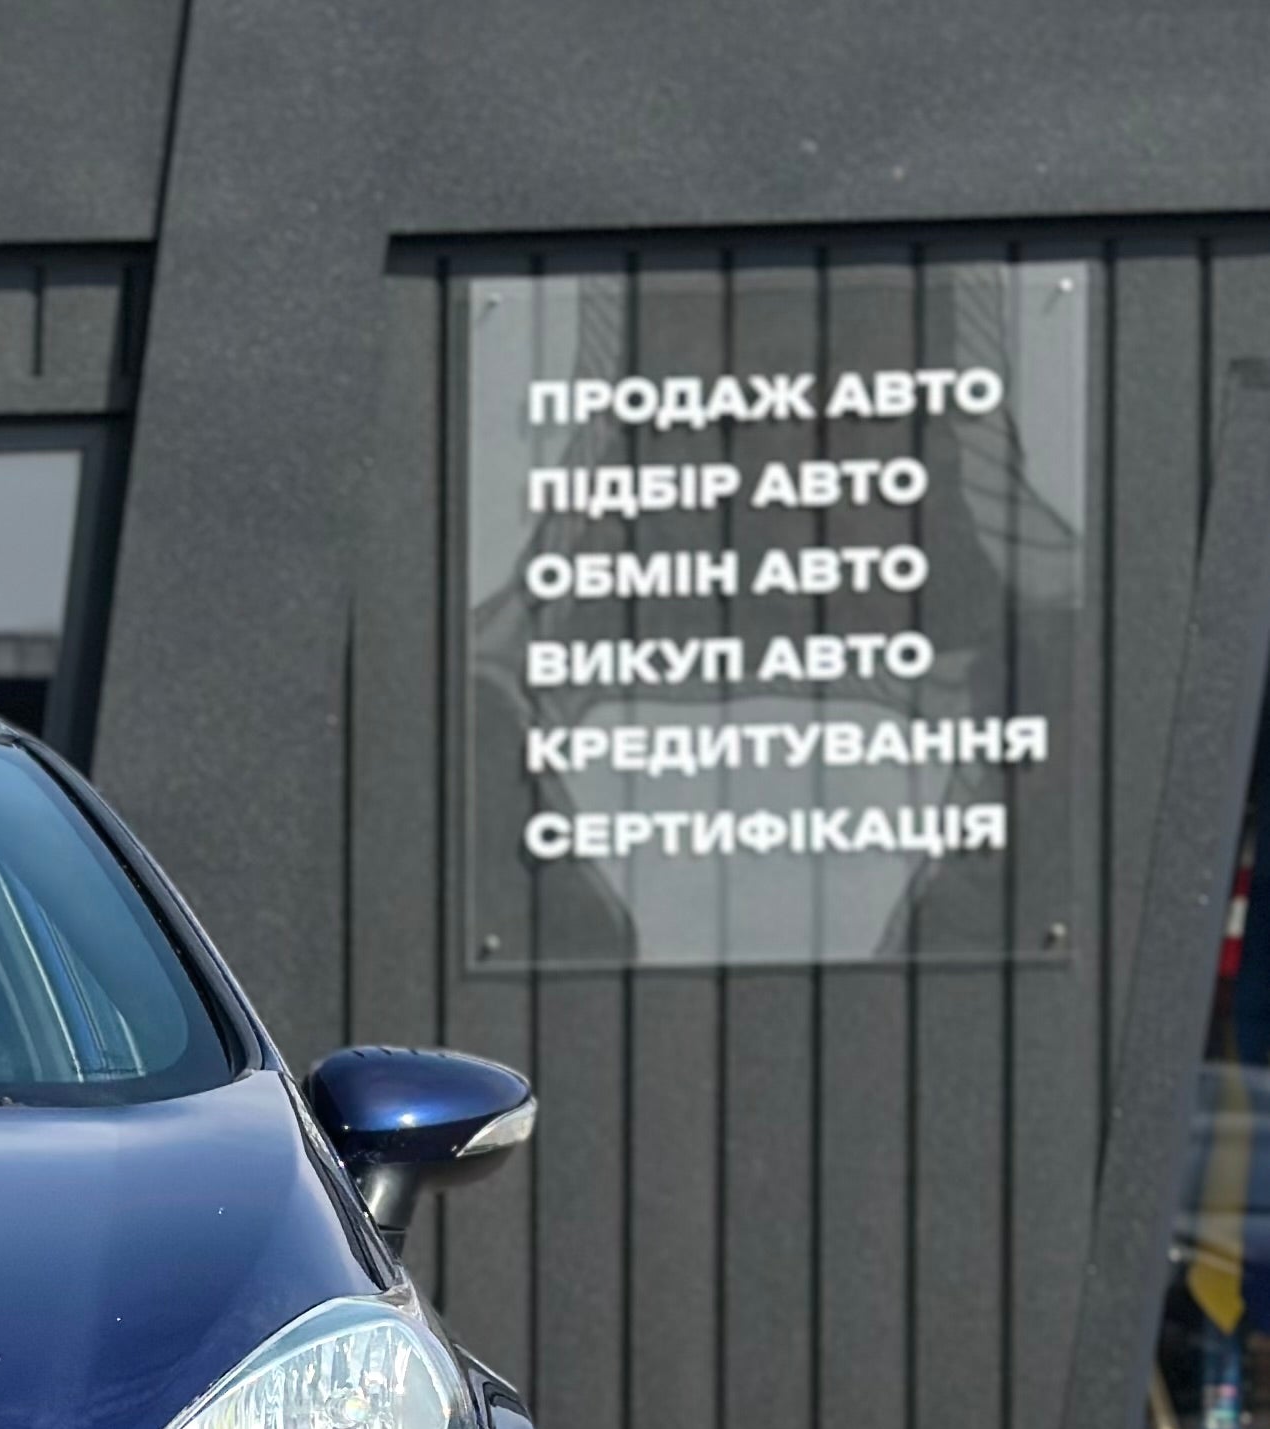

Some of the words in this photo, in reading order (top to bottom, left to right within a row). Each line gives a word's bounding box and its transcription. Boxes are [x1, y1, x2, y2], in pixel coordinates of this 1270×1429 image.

[528, 374, 815, 430] ПРОДАЖ
[827, 367, 1004, 418] АВТО
[528, 464, 741, 518] ПІДБІР
[753, 457, 929, 506] АВТО
[526, 551, 738, 599] ОБМІН
[753, 545, 929, 593] АВТО
[527, 640, 743, 686] ВИКУП
[759, 632, 934, 681] АВТО
[527, 717, 1049, 776] КРЕДИТУВАННЯ
[525, 804, 1008, 859] СЕРТИФІКАЦІЯ
